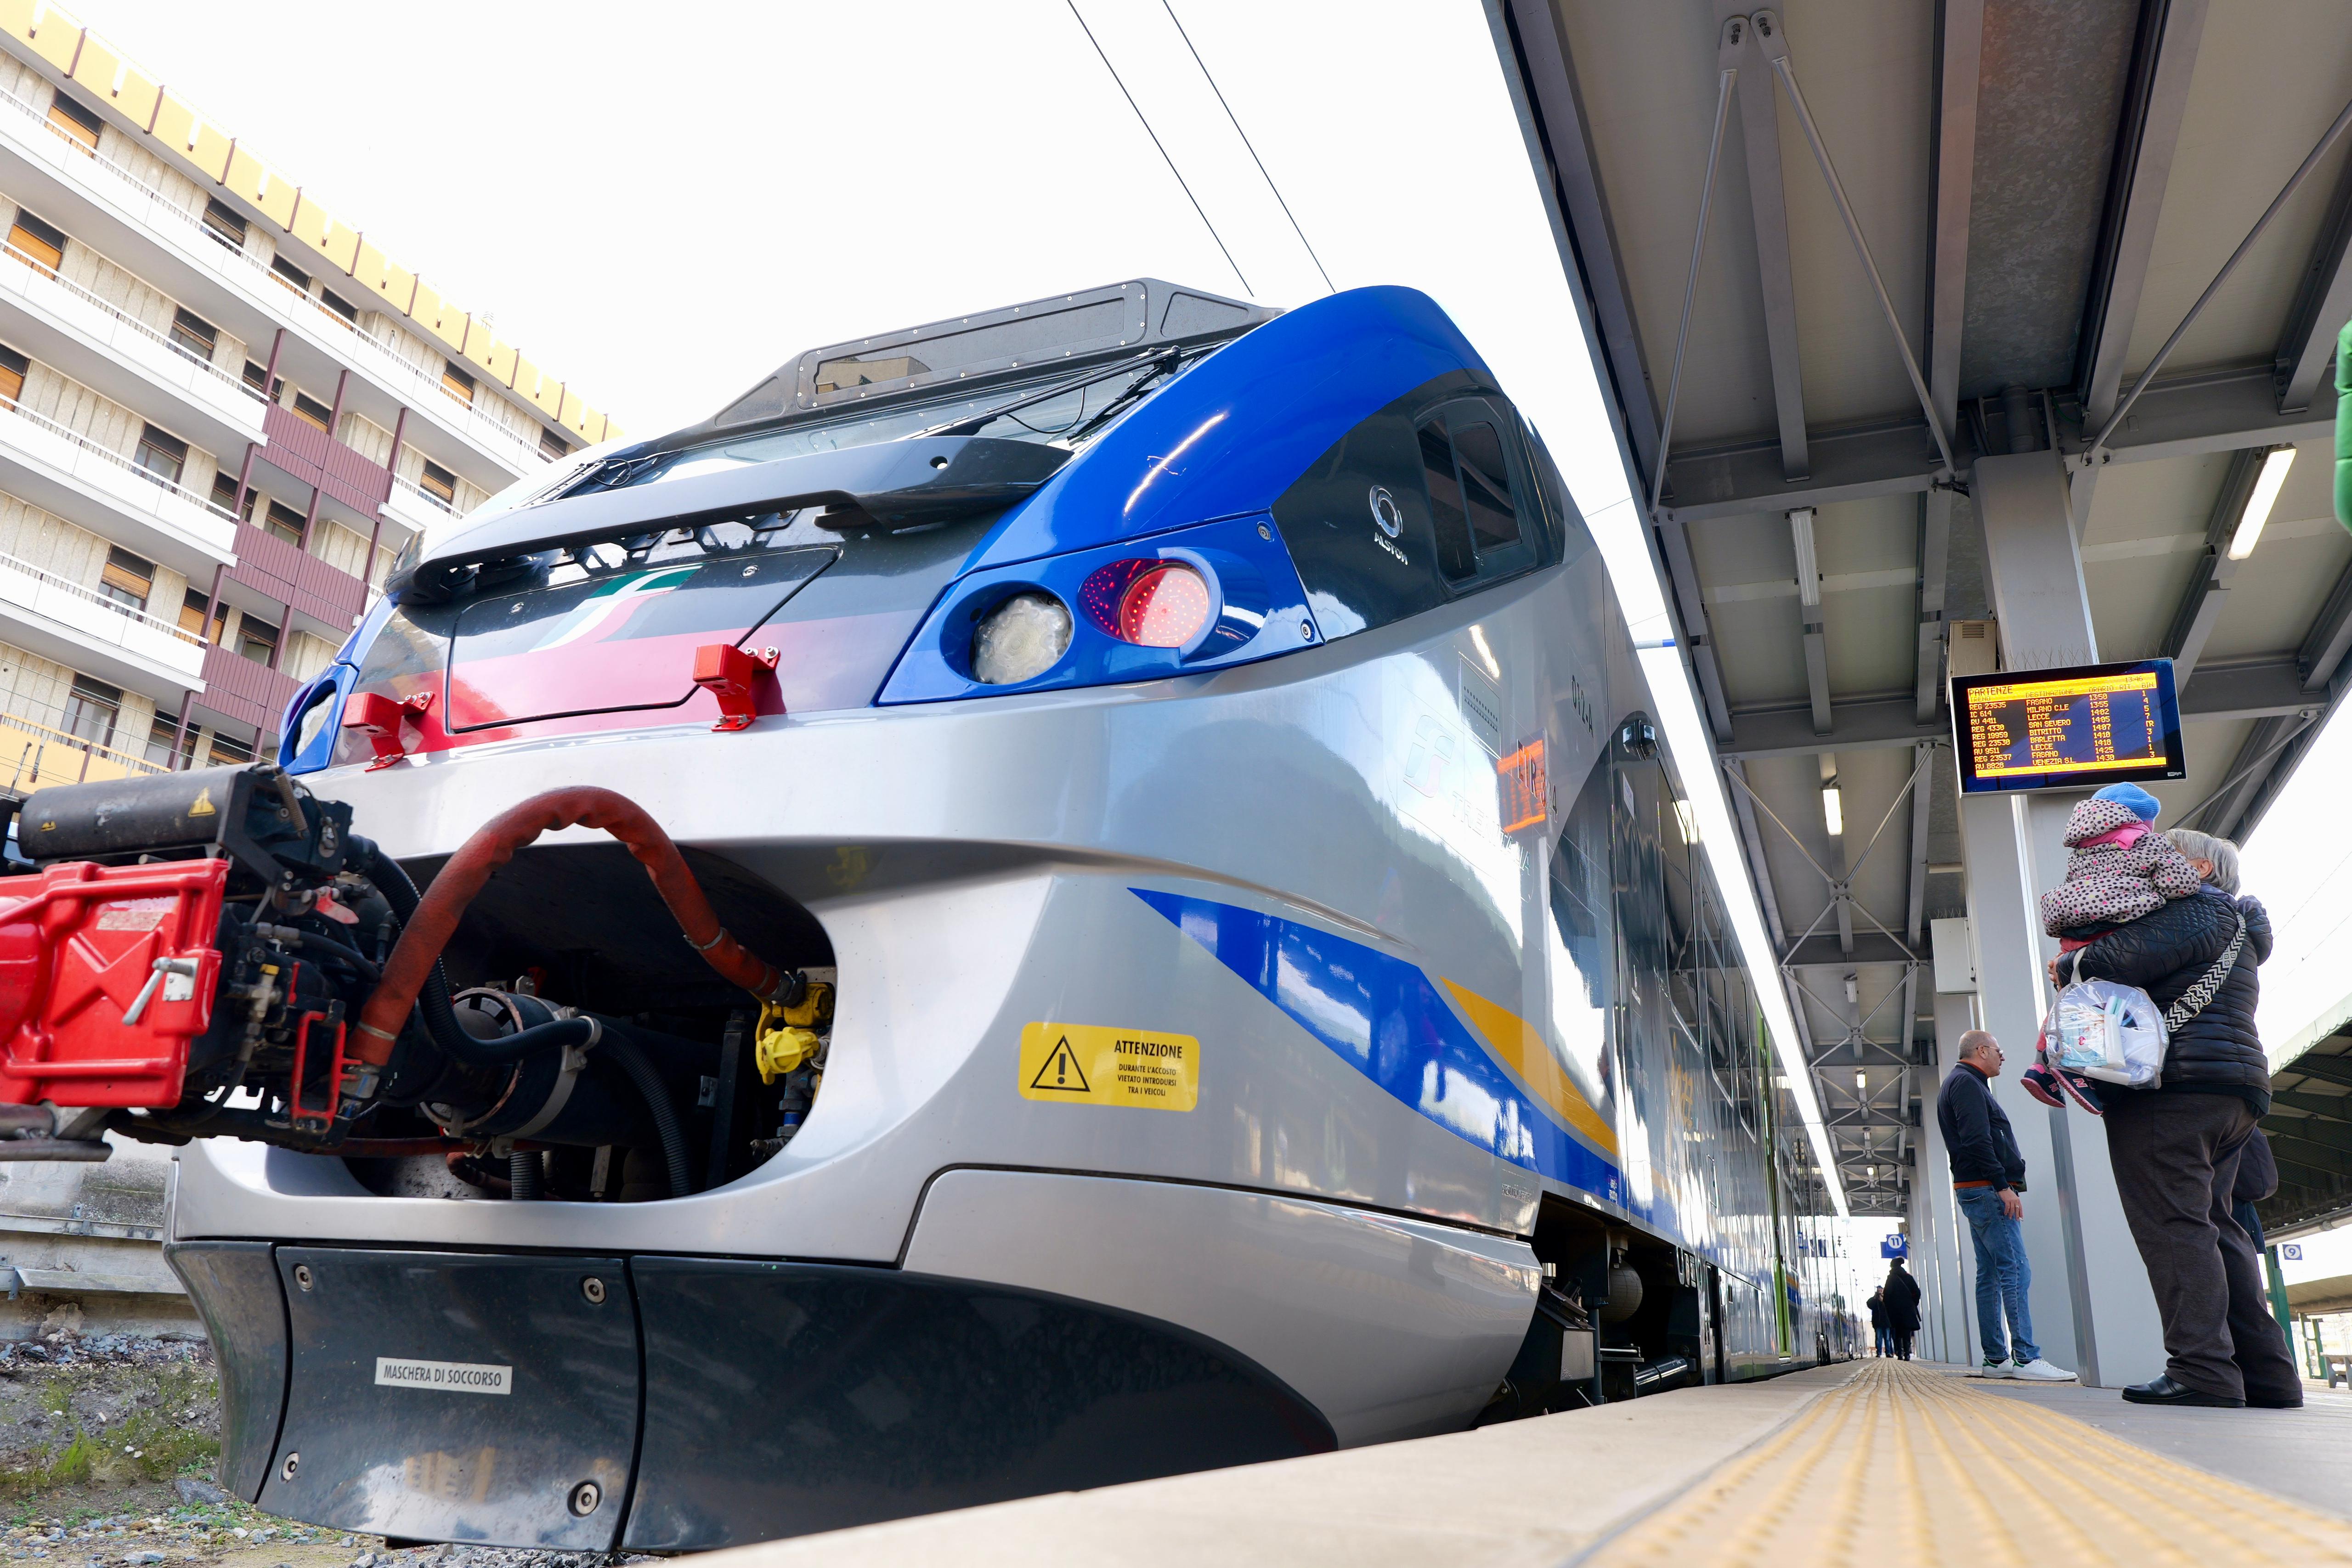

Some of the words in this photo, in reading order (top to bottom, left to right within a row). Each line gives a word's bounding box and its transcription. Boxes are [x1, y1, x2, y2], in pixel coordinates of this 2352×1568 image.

[1374, 532, 1408, 565] ALSTOM
[1969, 686, 2013, 697] PARTENZE
[2025, 688, 2075, 698] DESTINAZIONE
[1572, 675, 1594, 739] 012-A
[2026, 698, 2052, 706] FASANO
[2044, 719, 2071, 727] SEVERO
[2029, 727, 2062, 736] BITRITTO
[2030, 734, 2066, 743] BARLETTA
[1114, 1040, 1182, 1059] ATTENZIONE
[1119, 1064, 1146, 1073] DURANTE
[1148, 1066, 1176, 1076] L'ACCOSTO
[1118, 1074, 1141, 1083] VIETATO
[1142, 1077, 1176, 1086] INTRODURSI
[2073, 1078, 2088, 1088] N
[1144, 1088, 1166, 1096] VEICOLI
[384, 1365, 431, 1382] MASCHERA
[434, 1369, 445, 1382] DI
[448, 1369, 502, 1386] SOCCORSO
